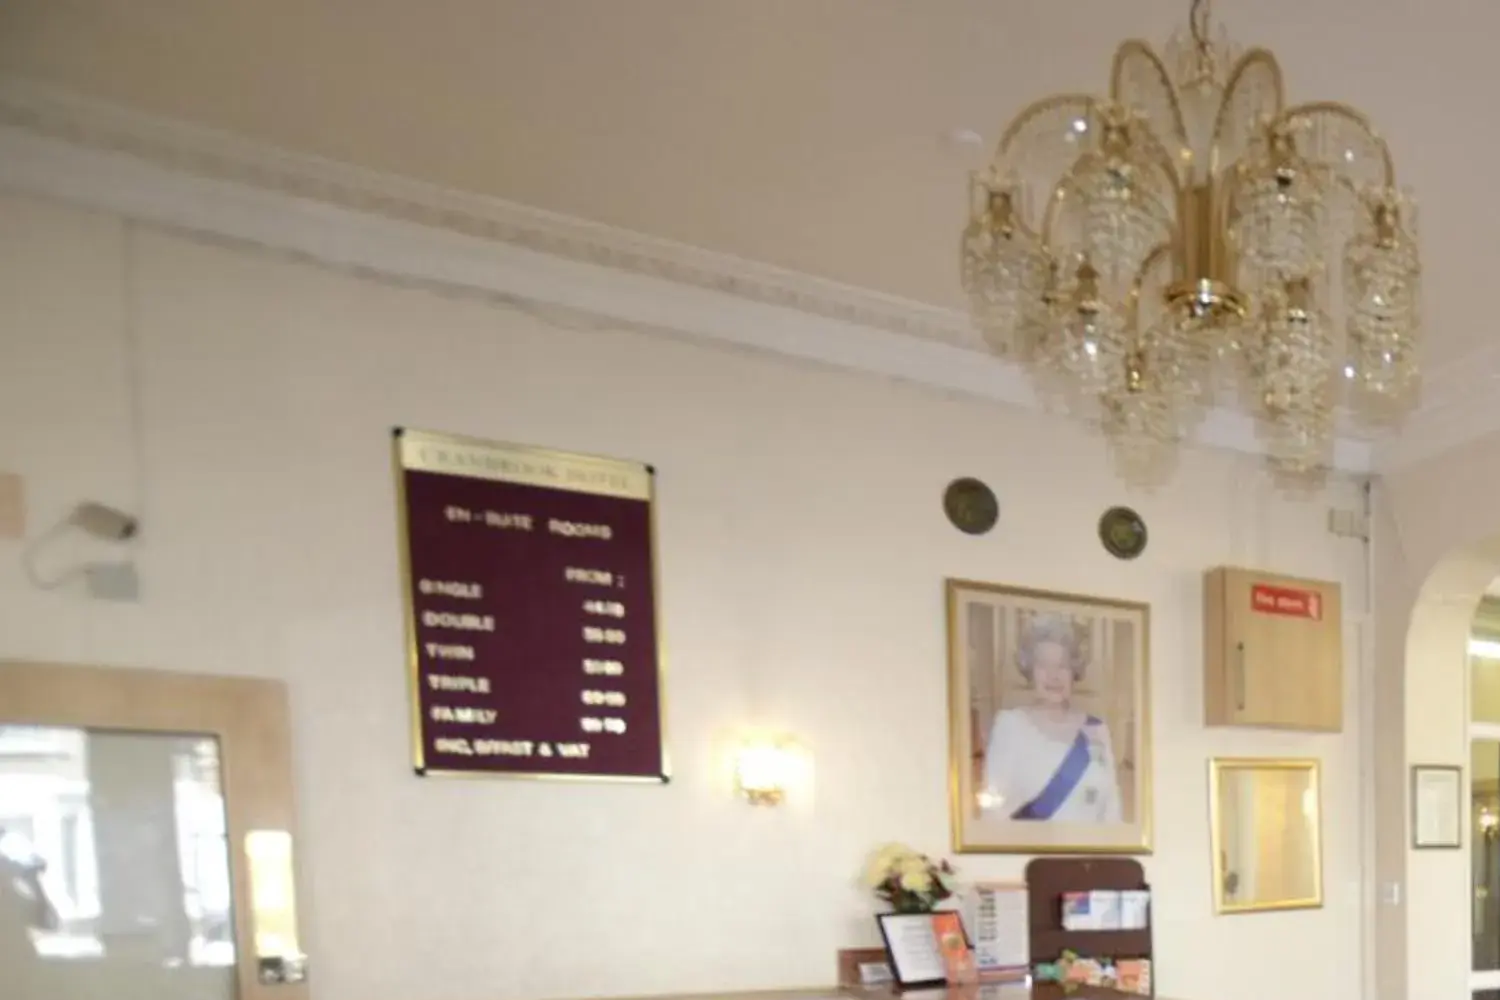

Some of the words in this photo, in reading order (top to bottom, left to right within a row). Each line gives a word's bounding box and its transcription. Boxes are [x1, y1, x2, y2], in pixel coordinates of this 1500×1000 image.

[548, 518, 613, 541] ROOMS
[418, 578, 483, 599] SINGLE
[422, 610, 495, 632] DOUBLE
[425, 642, 475, 661] TWIN
[428, 673, 490, 694] TRIPLE
[430, 706, 497, 724] FAMILY
[557, 742, 591, 758] VAT
